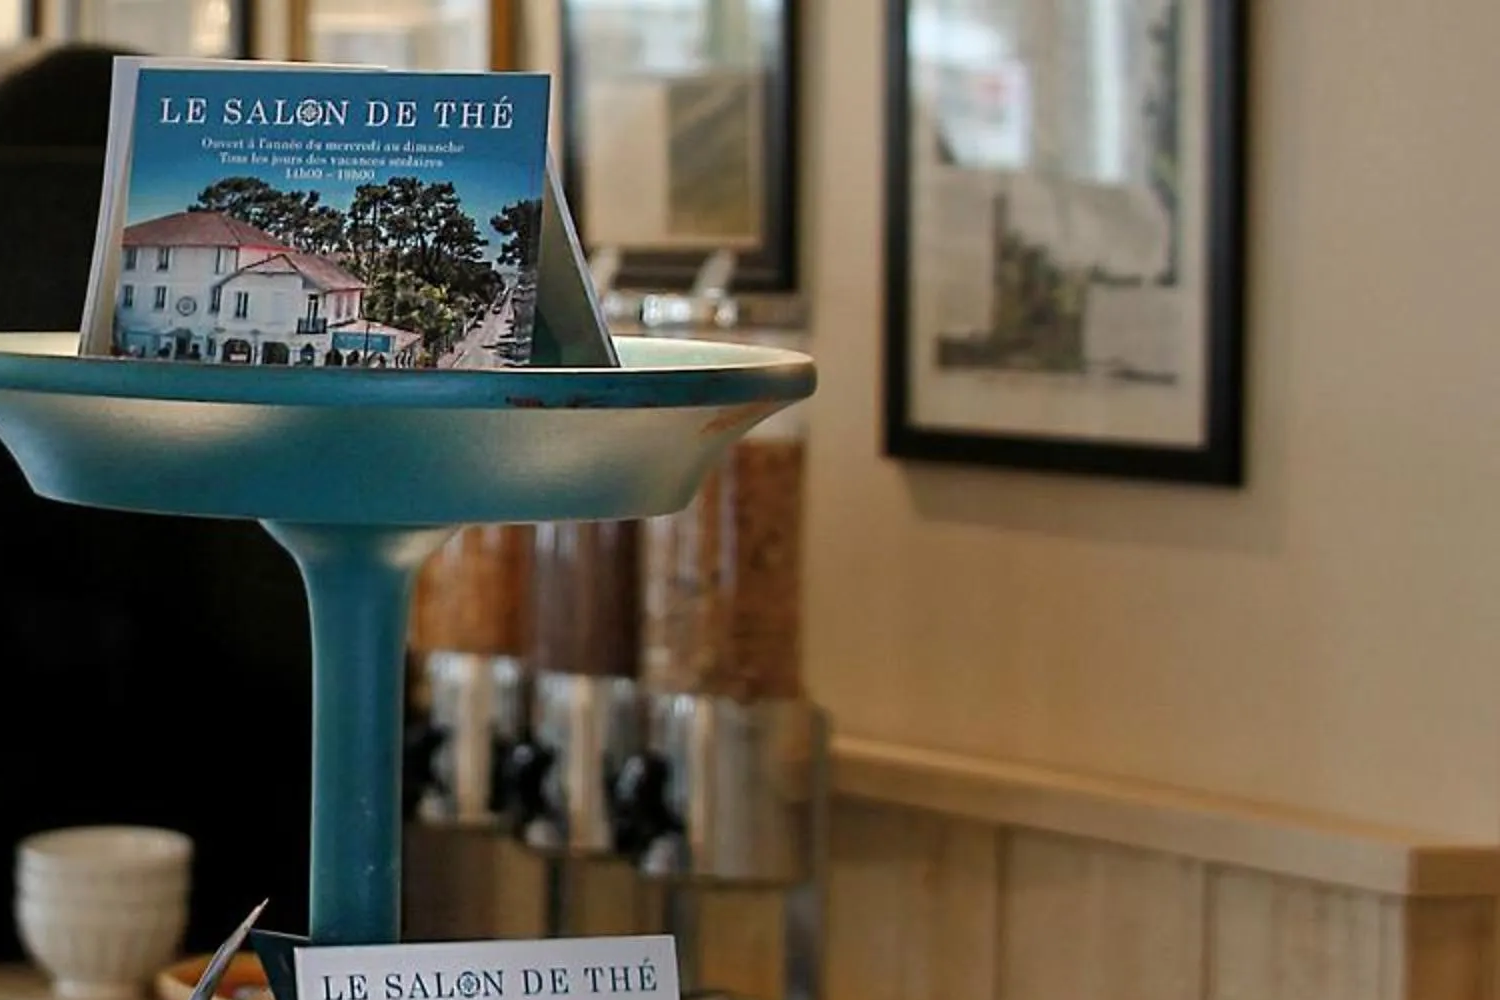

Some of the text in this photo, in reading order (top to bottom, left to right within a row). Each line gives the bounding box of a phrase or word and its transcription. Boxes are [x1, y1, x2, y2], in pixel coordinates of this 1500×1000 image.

[160, 95, 513, 129] LE SALON DE THÉ
[201, 137, 243, 150] Ouvert
[325, 138, 381, 152] mercredi
[403, 139, 465, 153] dimanche
[219, 151, 247, 164] Tous
[251, 152, 268, 165] les
[271, 153, 301, 166] jours
[305, 152, 326, 166] des
[330, 155, 386, 167] vacances
[385, 970, 503, 1000] SALON
[523, 968, 569, 995] DE
[583, 957, 657, 993] THÉ
